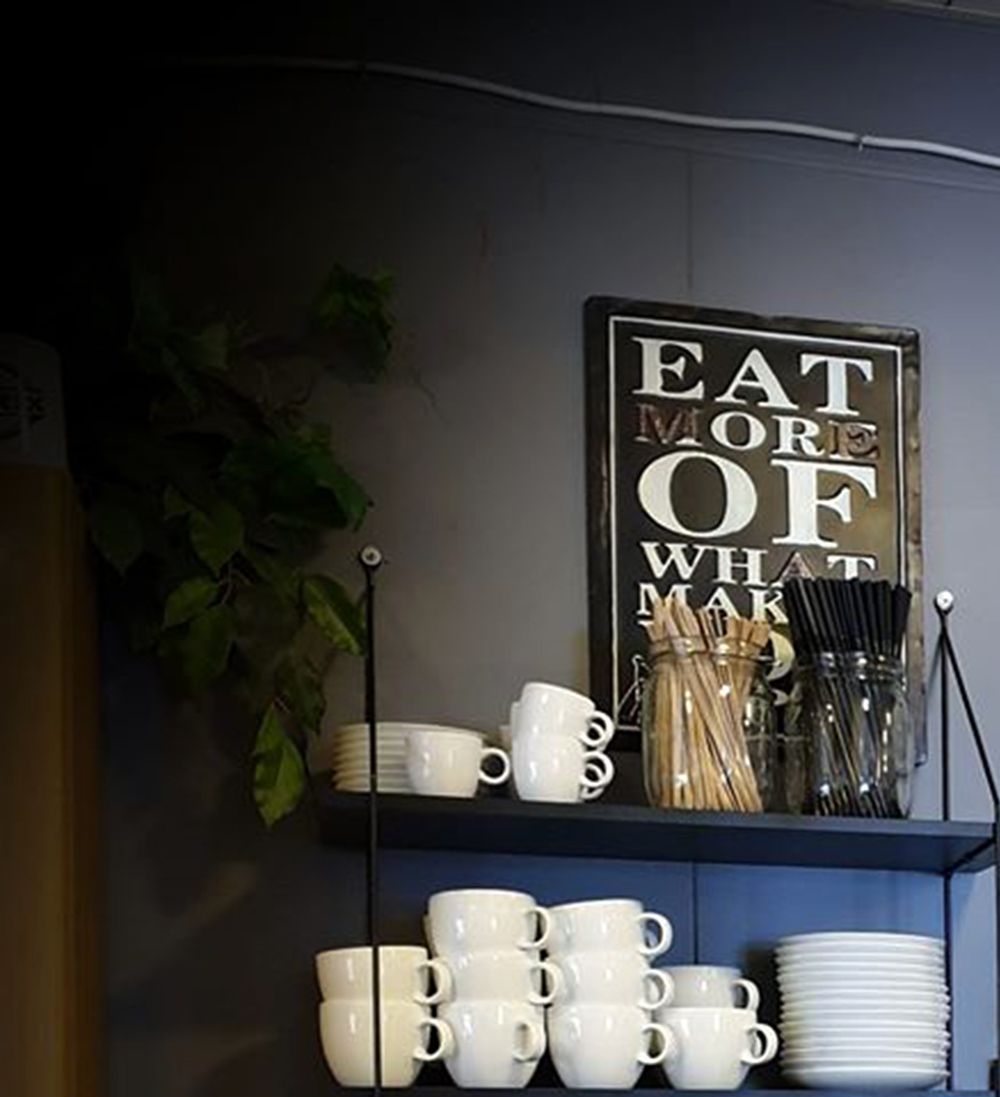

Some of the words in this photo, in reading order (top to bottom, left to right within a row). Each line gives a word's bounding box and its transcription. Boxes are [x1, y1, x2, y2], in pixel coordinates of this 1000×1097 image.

[632, 337, 874, 416] EAT
[635, 403, 880, 460] MORE
[637, 451, 877, 548] OF
[640, 541, 876, 587] WHAT
[637, 583, 789, 625] MAK
